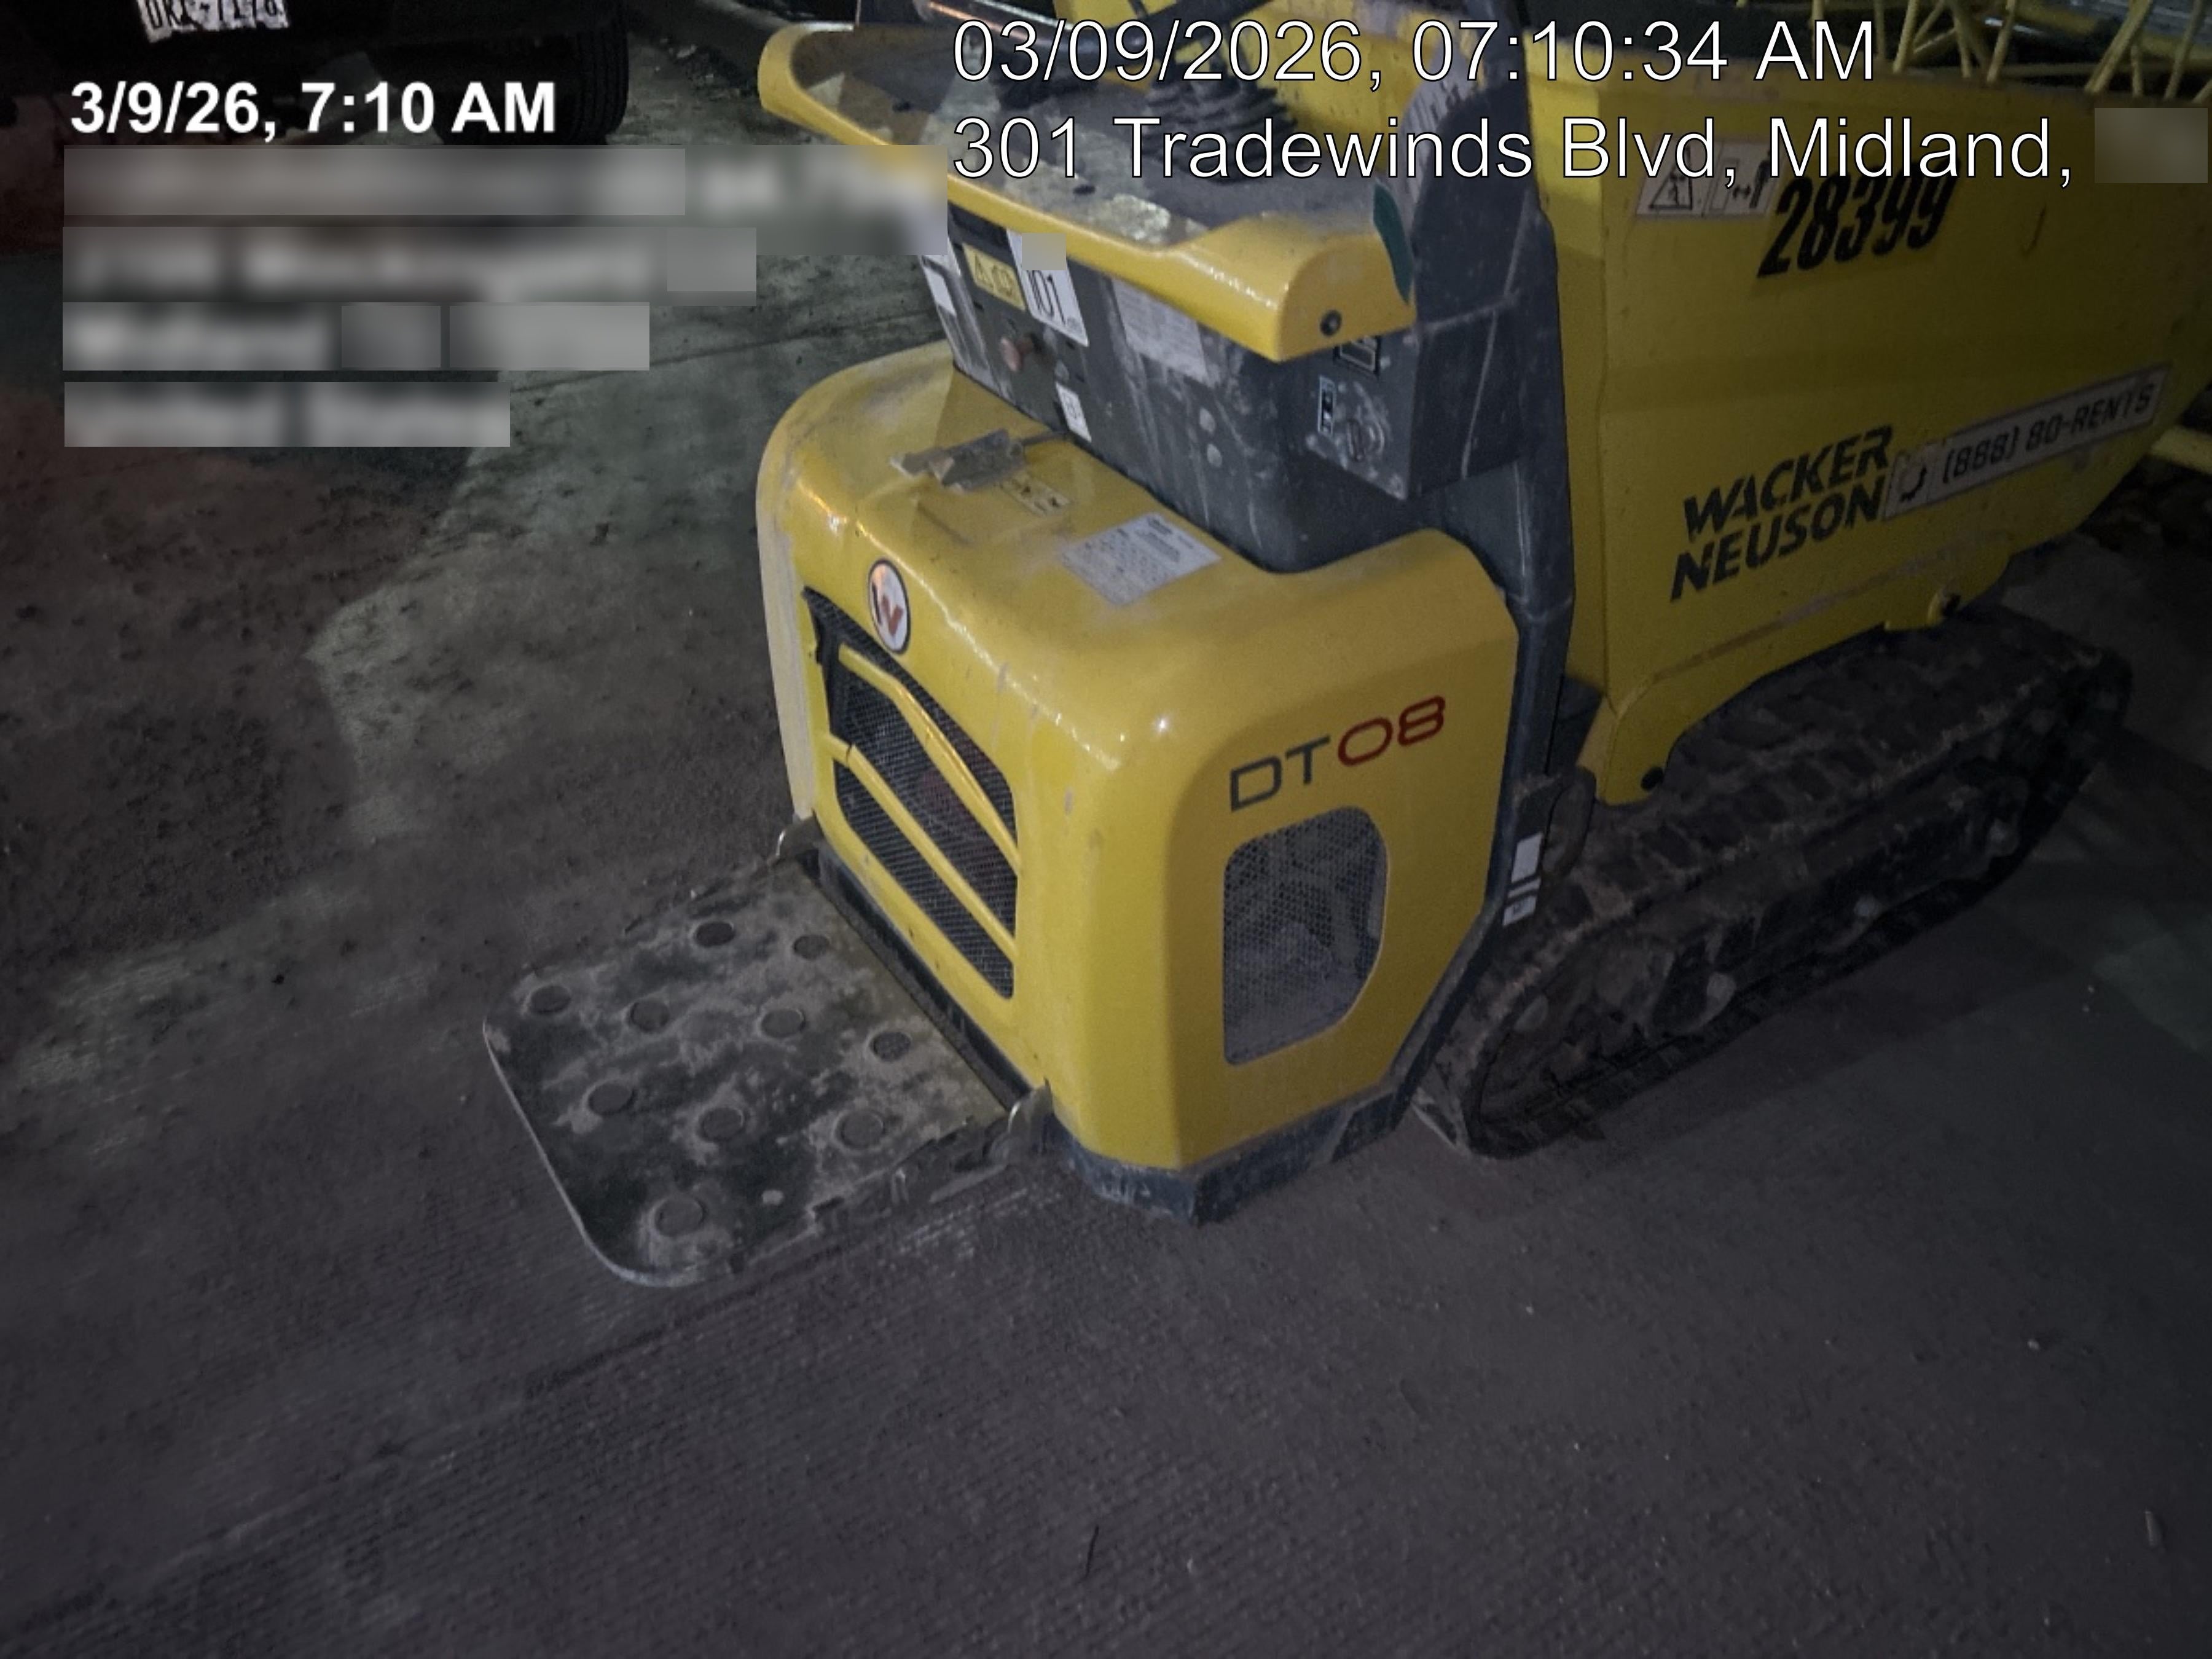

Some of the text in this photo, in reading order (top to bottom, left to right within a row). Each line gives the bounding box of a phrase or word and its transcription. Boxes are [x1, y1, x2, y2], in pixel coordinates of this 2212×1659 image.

[1757, 158, 1961, 277] 28399
[1684, 425, 1892, 543] WACKER
[1943, 383, 2154, 484] (888) 80-RENTS
[1670, 476, 1886, 603] NEUSON
[1231, 695, 1445, 812] DT08
